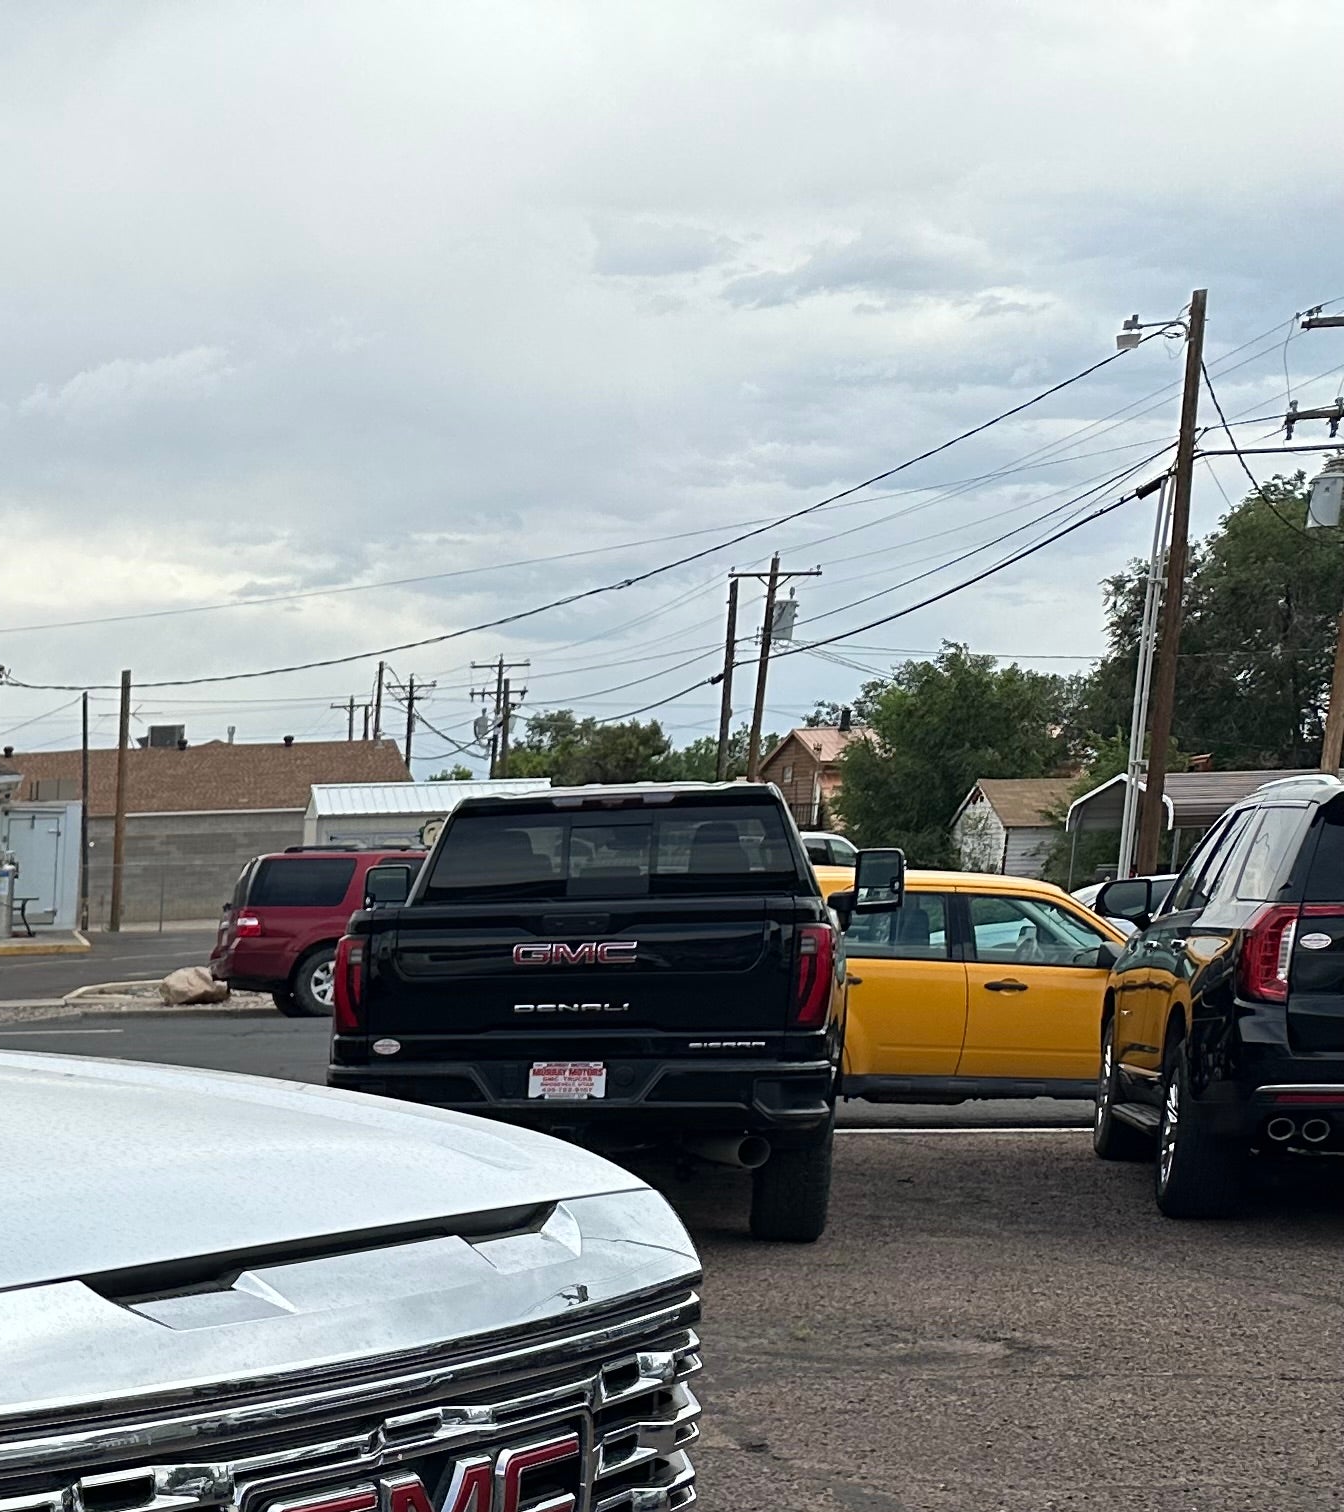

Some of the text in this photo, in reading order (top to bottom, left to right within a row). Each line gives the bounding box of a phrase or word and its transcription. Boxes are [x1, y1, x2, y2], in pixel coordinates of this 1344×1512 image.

[512, 941, 638, 965] GMC
[514, 1003, 630, 1013] DENALI
[533, 1068, 603, 1076] MURRAY MOTORS
